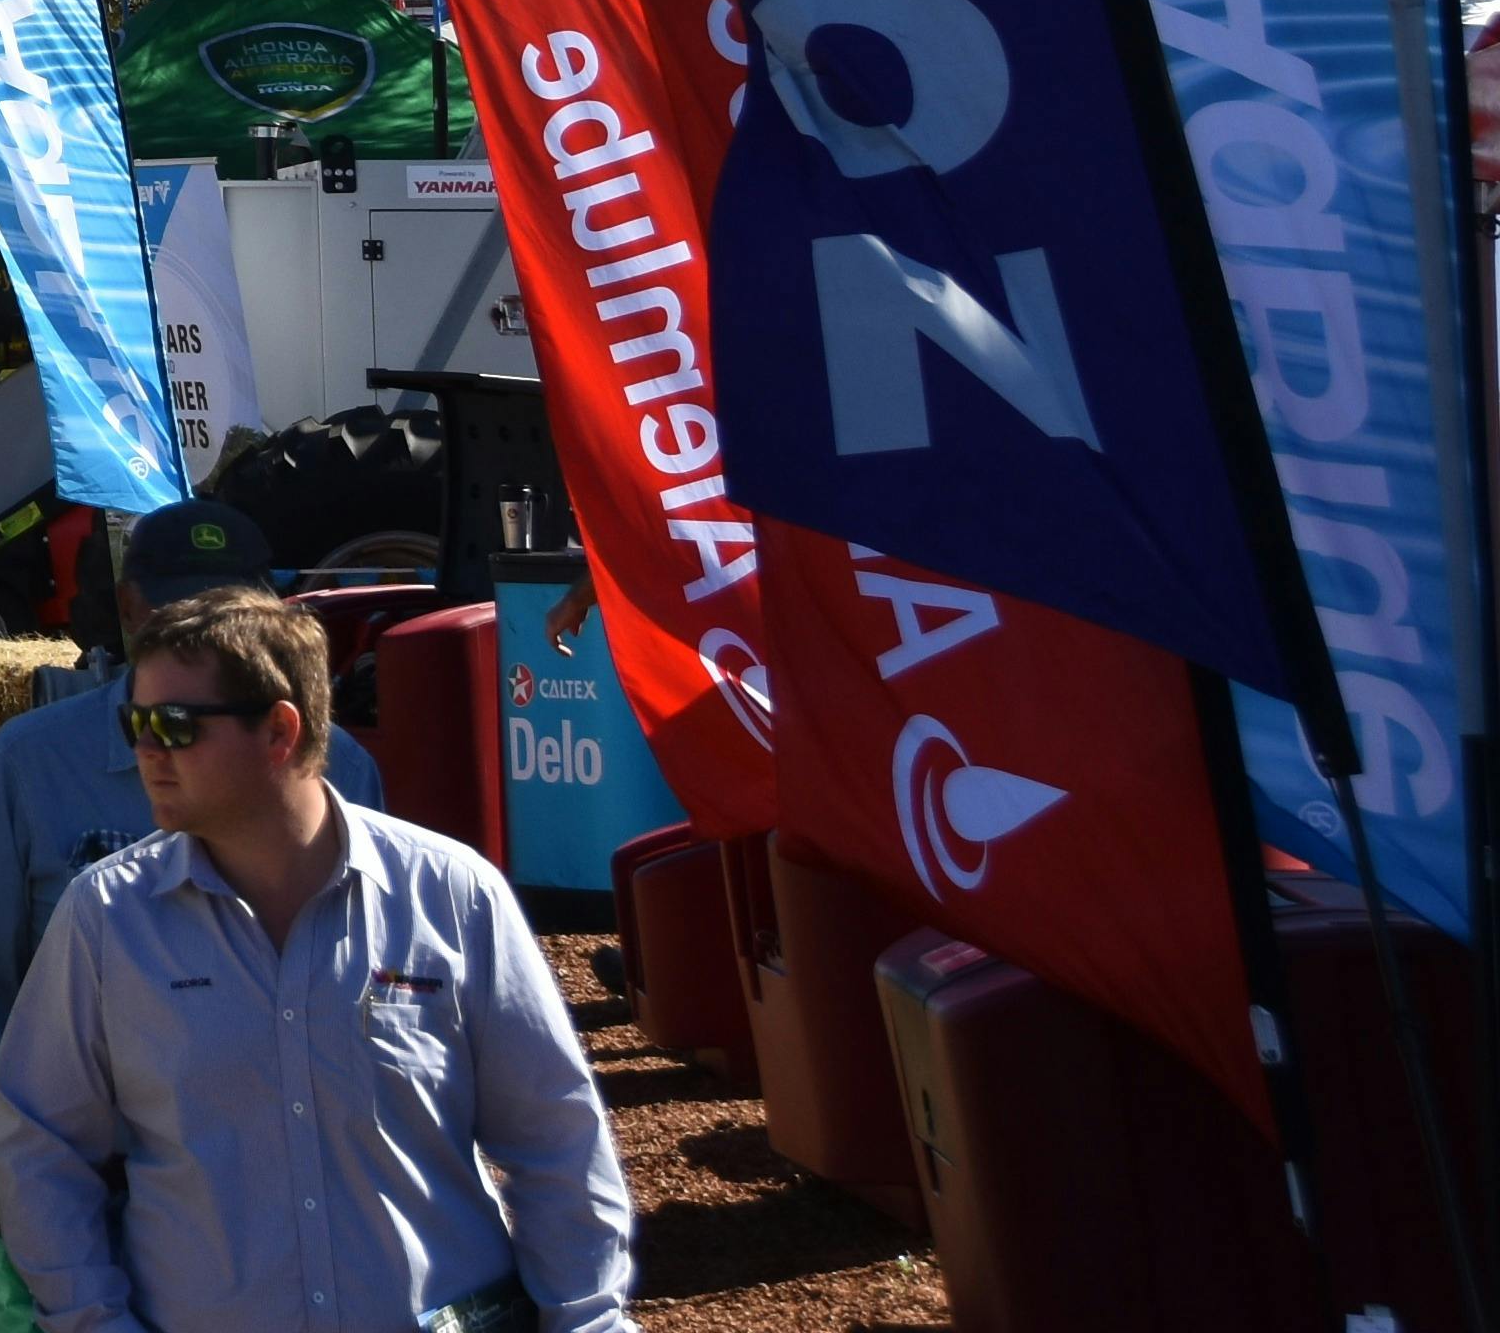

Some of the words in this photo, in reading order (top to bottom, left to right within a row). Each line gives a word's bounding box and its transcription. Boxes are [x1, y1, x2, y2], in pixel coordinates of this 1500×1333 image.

[243, 42, 328, 55] HONDA
[224, 54, 355, 70] AUSTRALIA
[230, 64, 355, 80] APPROVED
[257, 84, 333, 94] HONDA
[540, 676, 599, 701] CALTEX
[509, 716, 603, 786] Delo
